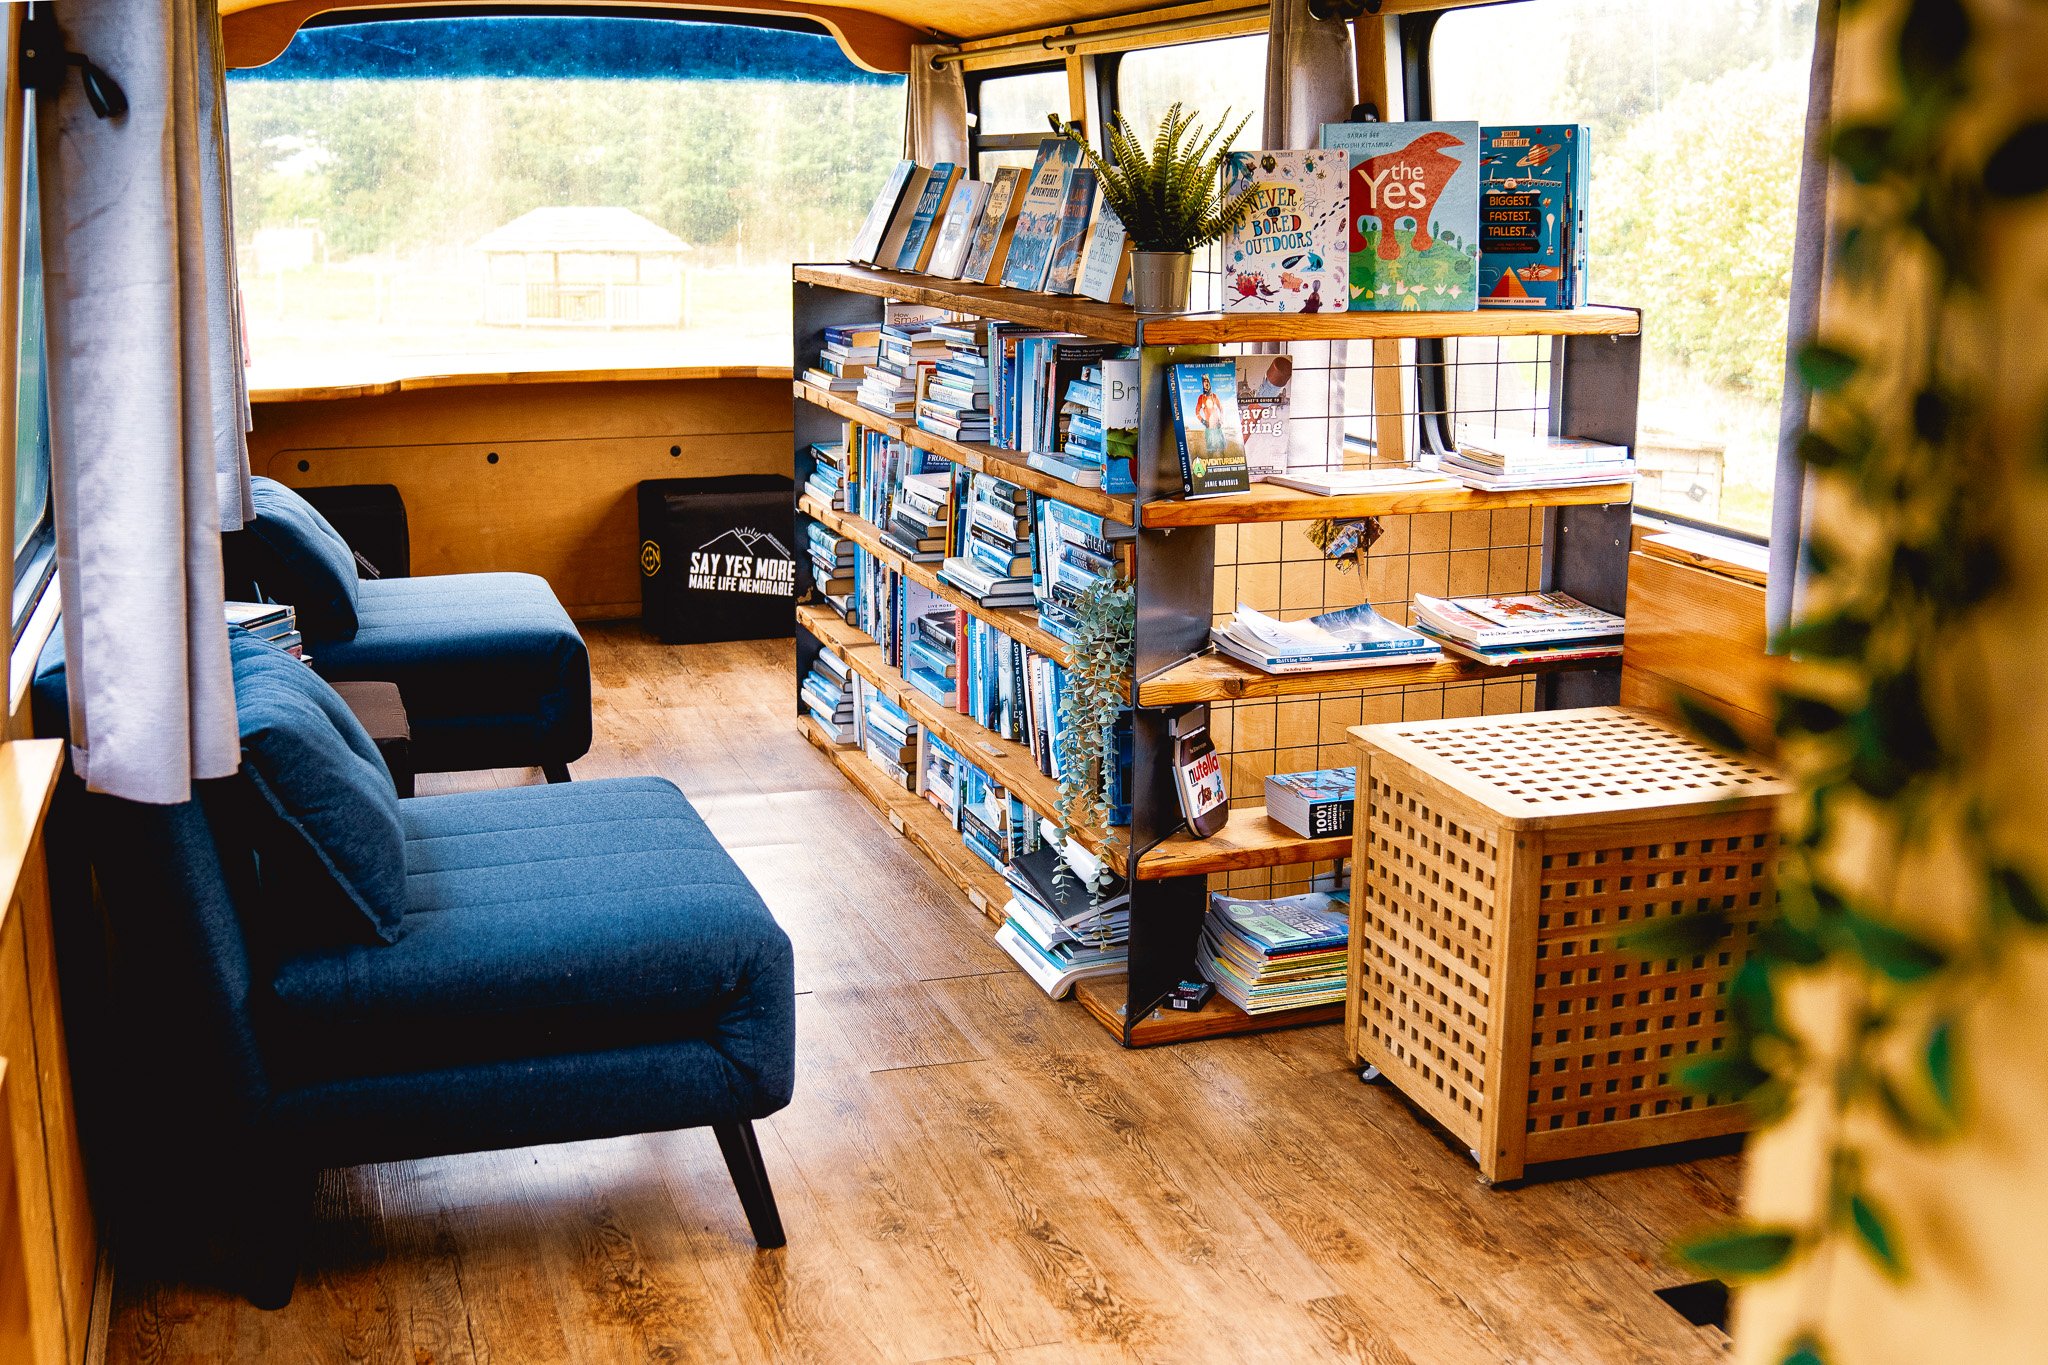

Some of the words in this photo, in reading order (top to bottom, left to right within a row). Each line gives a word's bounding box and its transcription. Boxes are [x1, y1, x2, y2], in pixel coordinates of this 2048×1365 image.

[1041, 174, 1058, 185] GREAT
[1391, 161, 1424, 180] the
[1031, 186, 1060, 198] ADVENTURERS
[1358, 169, 1427, 209] Yes
[1248, 187, 1297, 214] NEVER
[1489, 195, 1532, 206] BIGGEST,
[1064, 205, 1088, 218] BEYOND
[1489, 211, 1531, 222] FASTEST,
[1252, 215, 1302, 237] BORED
[1245, 231, 1313, 255] OUTDOORS
[894, 315, 925, 325] small
[1238, 405, 1277, 420] ravel
[1243, 420, 1283, 437] iting
[1204, 480, 1218, 488] JAMIE
[1086, 534, 1106, 556] HEAT
[690, 552, 720, 575] SAY
[725, 554, 752, 579] YES
[755, 558, 796, 582] MORE
[689, 574, 716, 590] MAKE
[717, 577, 737, 592] LIFE
[739, 578, 794, 597] MEMORABLE
[1188, 752, 1219, 784] nutella
[1316, 805, 1327, 834] 1001
